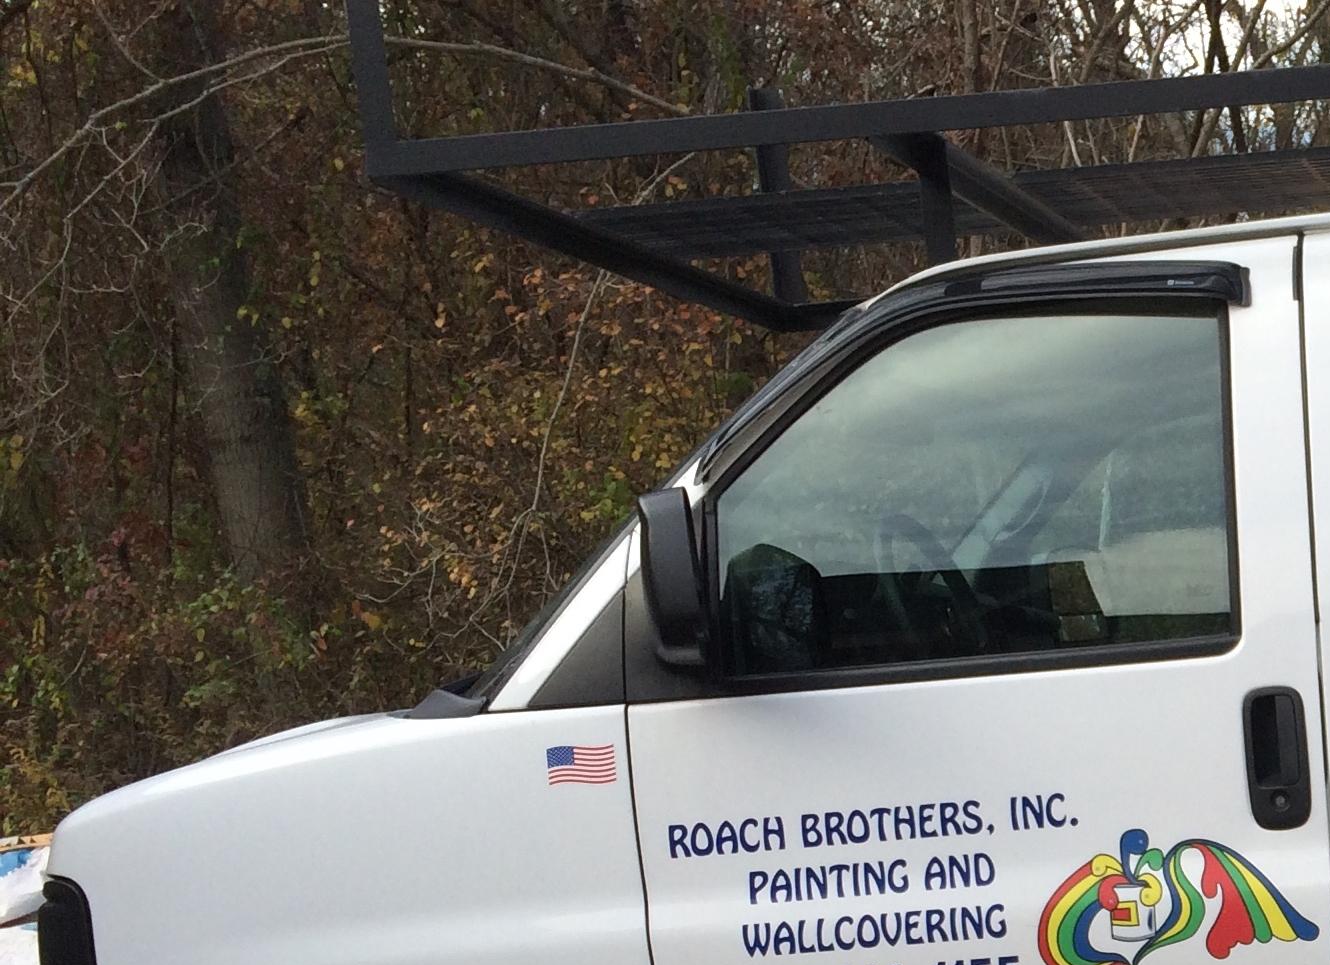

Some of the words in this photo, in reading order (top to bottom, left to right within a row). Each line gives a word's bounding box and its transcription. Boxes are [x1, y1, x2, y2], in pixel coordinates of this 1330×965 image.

[667, 815, 786, 859] ROACH
[800, 799, 995, 849] BROTHERS,
[1009, 792, 1079, 832] INC.
[748, 858, 910, 905] PAINTING
[924, 852, 996, 891] AND
[741, 903, 1008, 958] WALLCOVERING
